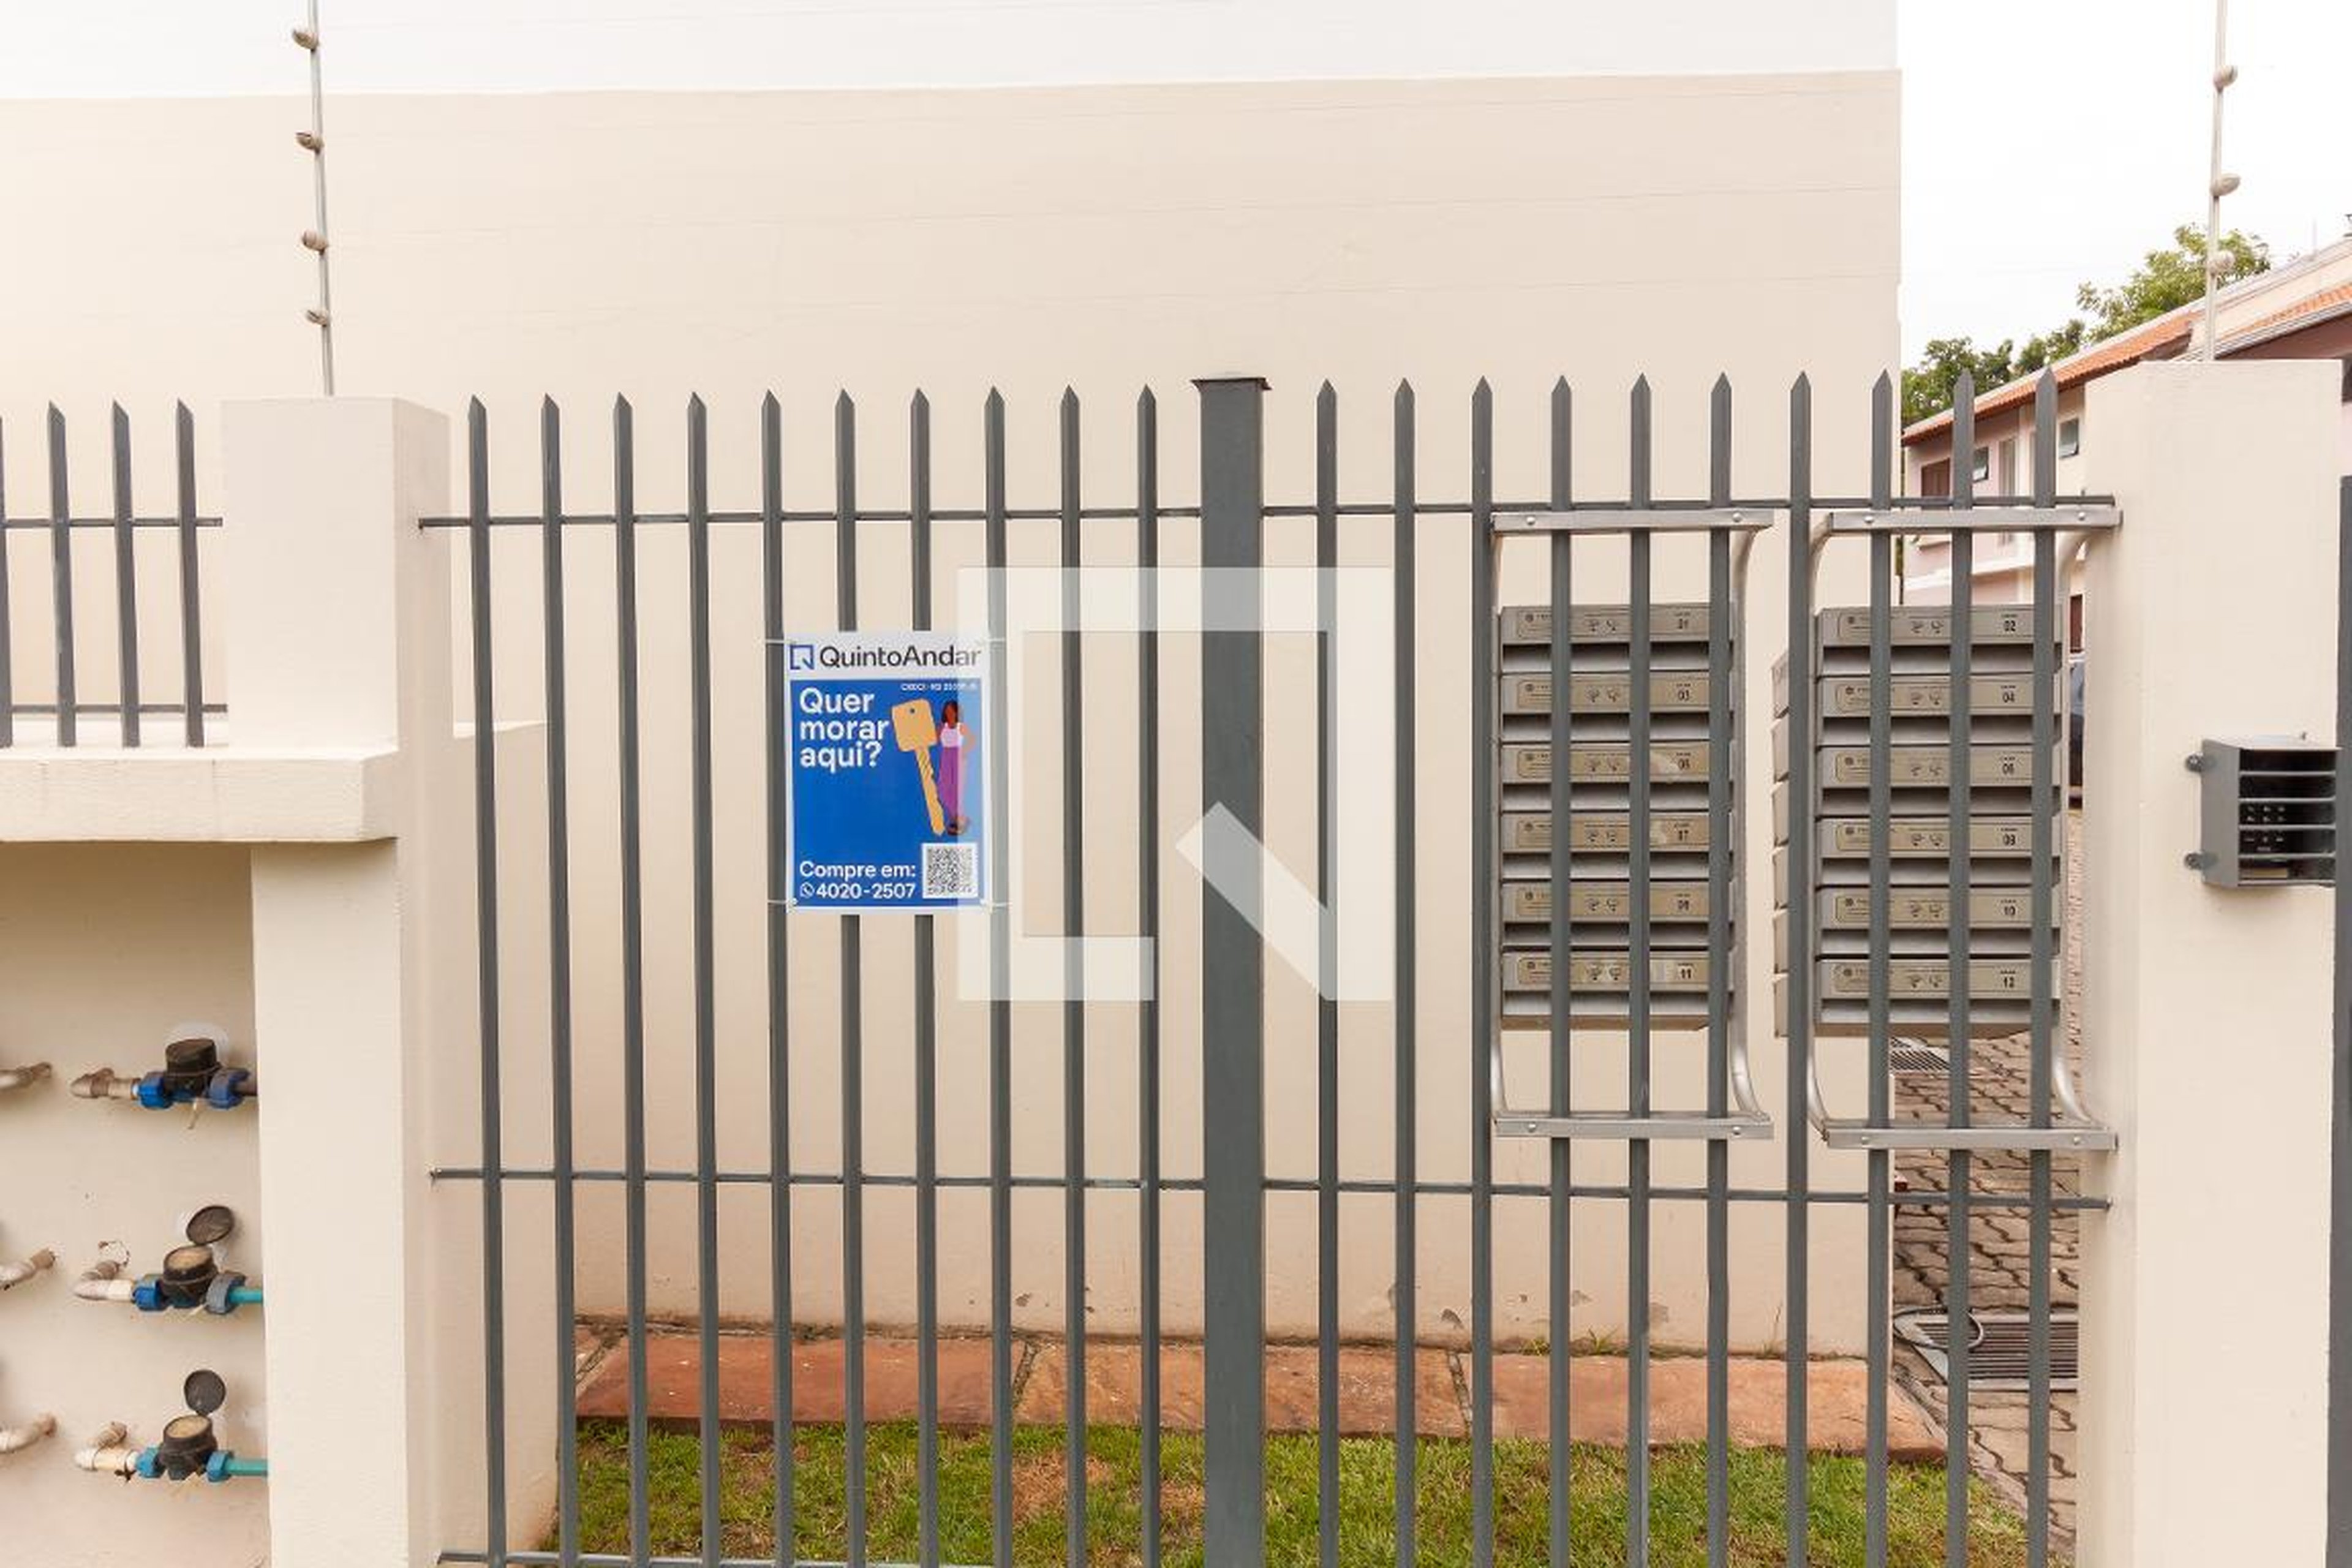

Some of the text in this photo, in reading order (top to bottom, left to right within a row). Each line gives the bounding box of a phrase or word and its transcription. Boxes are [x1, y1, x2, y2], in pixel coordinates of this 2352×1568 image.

[2003, 620, 2016, 632] 02
[820, 645, 982, 668] QuintoAndar
[799, 687, 875, 715] Quer
[2002, 691, 2015, 704] 04
[799, 719, 889, 741] morar
[800, 742, 883, 773] aqui?
[799, 861, 916, 879] Compre em:
[816, 883, 916, 899] 4020-2507
[2003, 905, 2016, 917] 10
[1681, 969, 1692, 979] 11
[2003, 976, 2015, 989] 12
